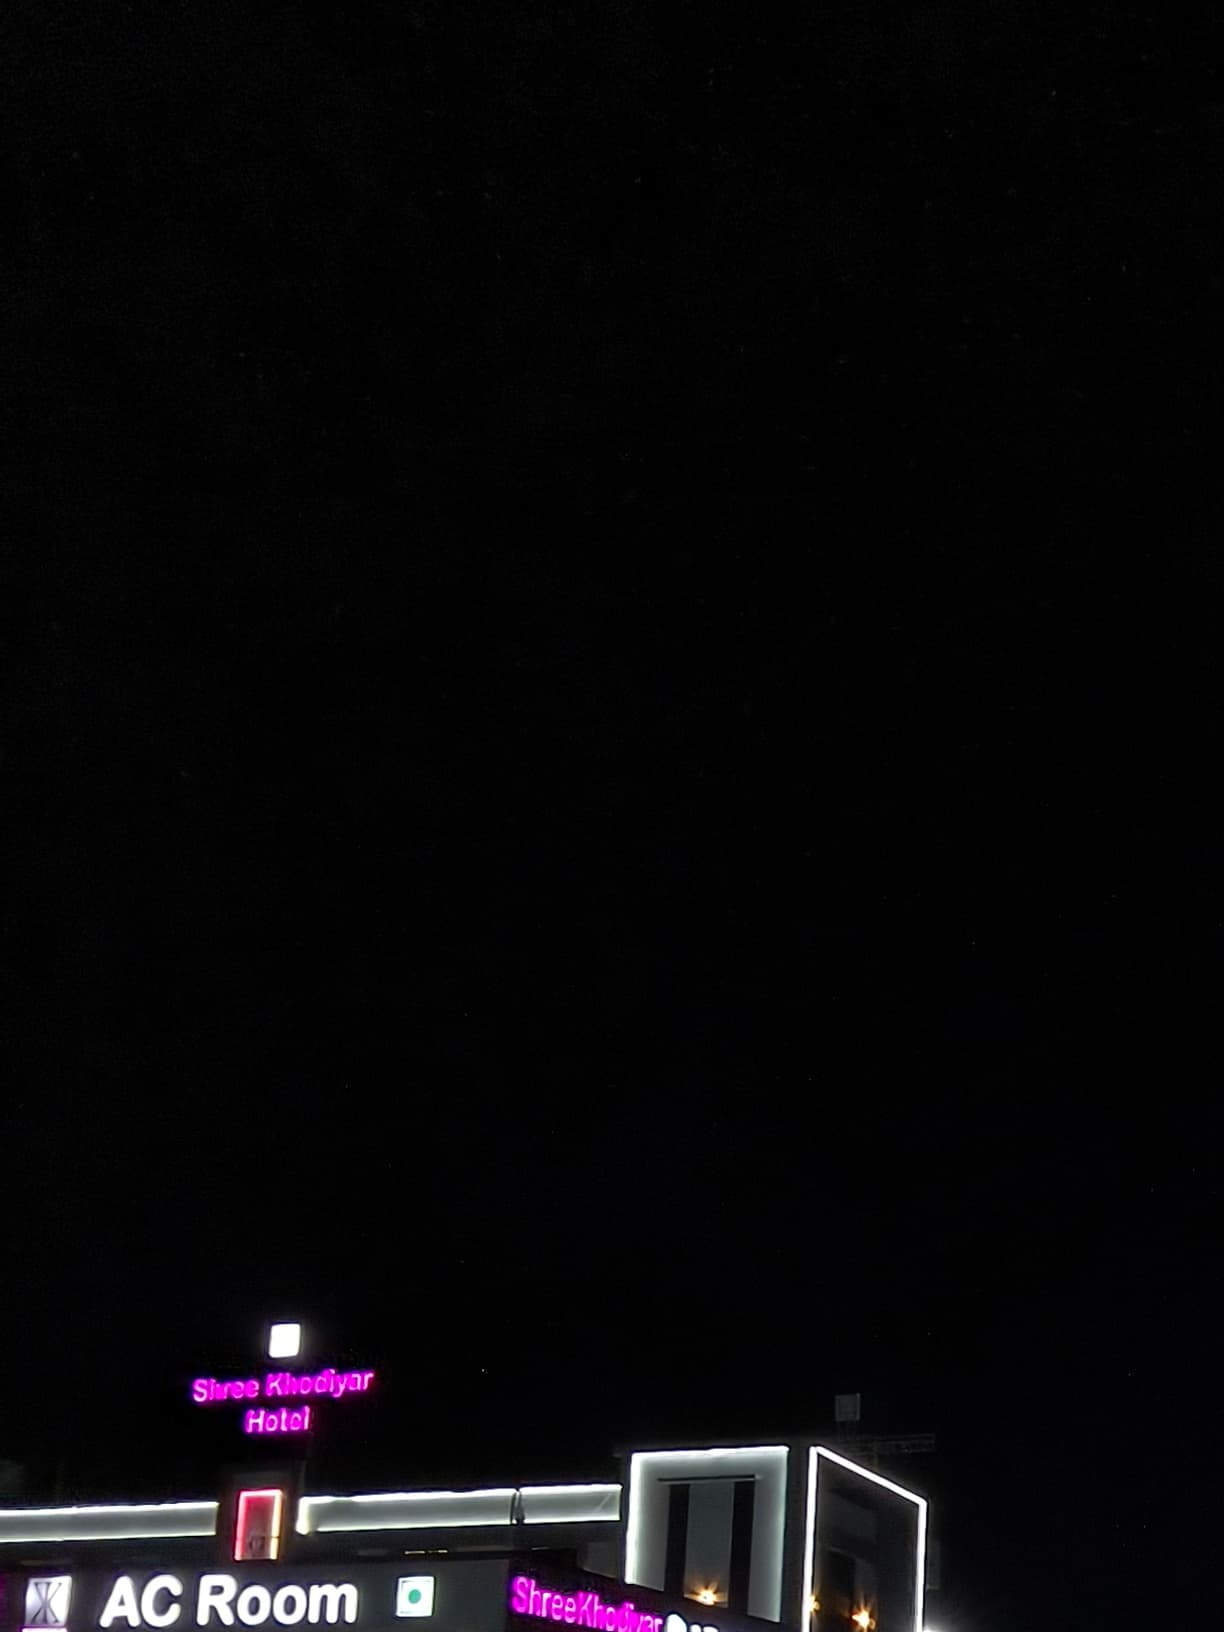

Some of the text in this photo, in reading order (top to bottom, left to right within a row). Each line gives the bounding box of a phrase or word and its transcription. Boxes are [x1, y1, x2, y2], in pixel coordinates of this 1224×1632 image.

[192, 1368, 375, 1403] Shree Khodiyar
[245, 1405, 311, 1434] Hotel
[99, 1574, 358, 1628] AC Room
